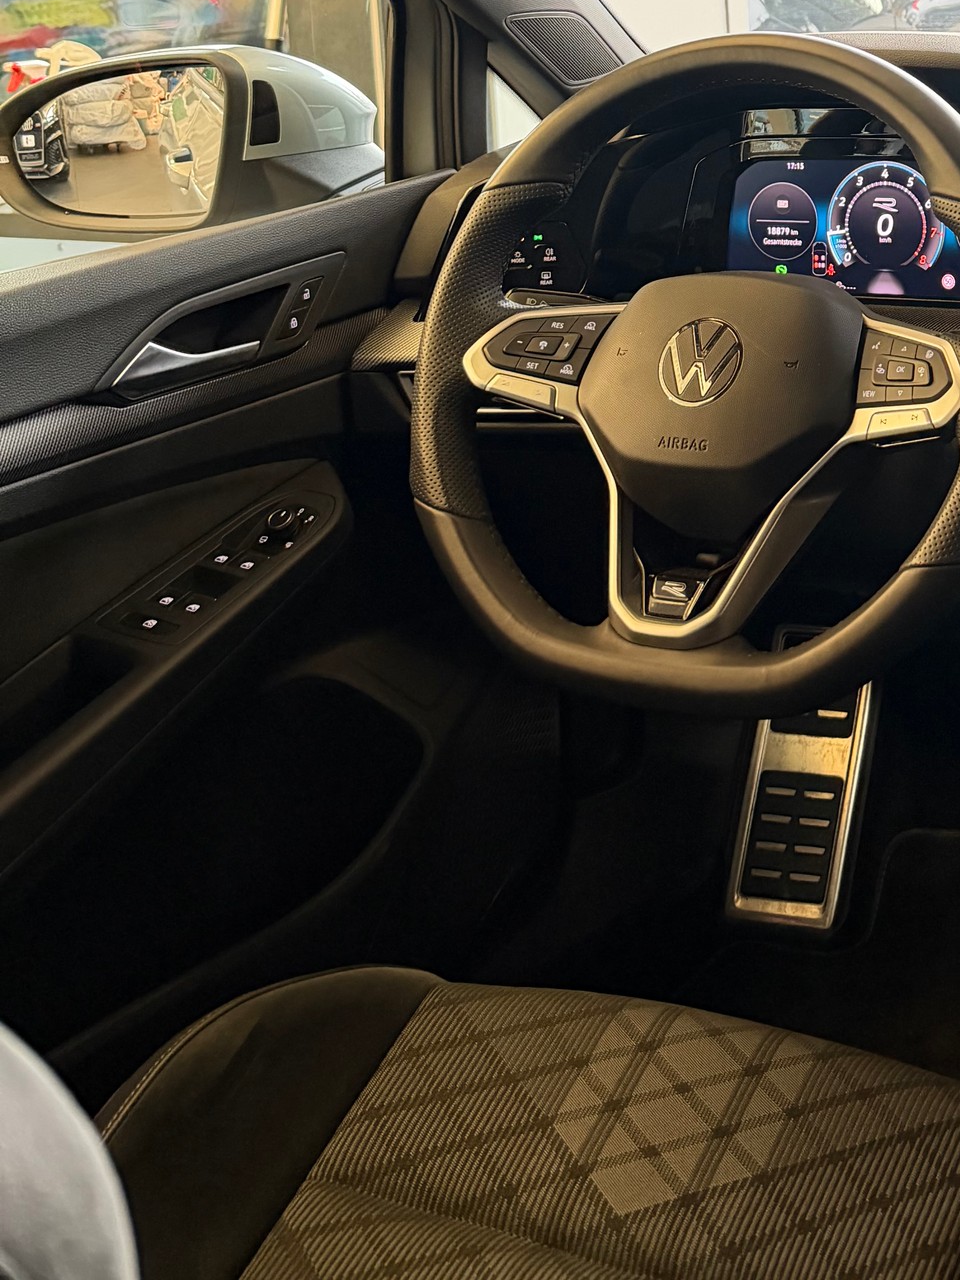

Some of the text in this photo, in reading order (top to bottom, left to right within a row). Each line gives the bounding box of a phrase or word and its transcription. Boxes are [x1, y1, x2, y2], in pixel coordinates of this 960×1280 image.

[787, 162, 805, 170] 17:15
[881, 169, 889, 179] 4
[856, 176, 864, 186] 3
[906, 177, 914, 187] 5
[838, 197, 846, 207] 2
[925, 198, 932, 209] 6
[877, 213, 894, 237] 0
[767, 227, 790, 236] 18879
[930, 228, 937, 237] 7
[763, 237, 802, 246] Gesamtstrecke
[843, 252, 851, 262] 0
[919, 255, 927, 264] 8
[551, 321, 564, 329] RES
[526, 361, 539, 370] SET
[862, 390, 876, 398] VIEW
[658, 436, 708, 452] AIRBAG
